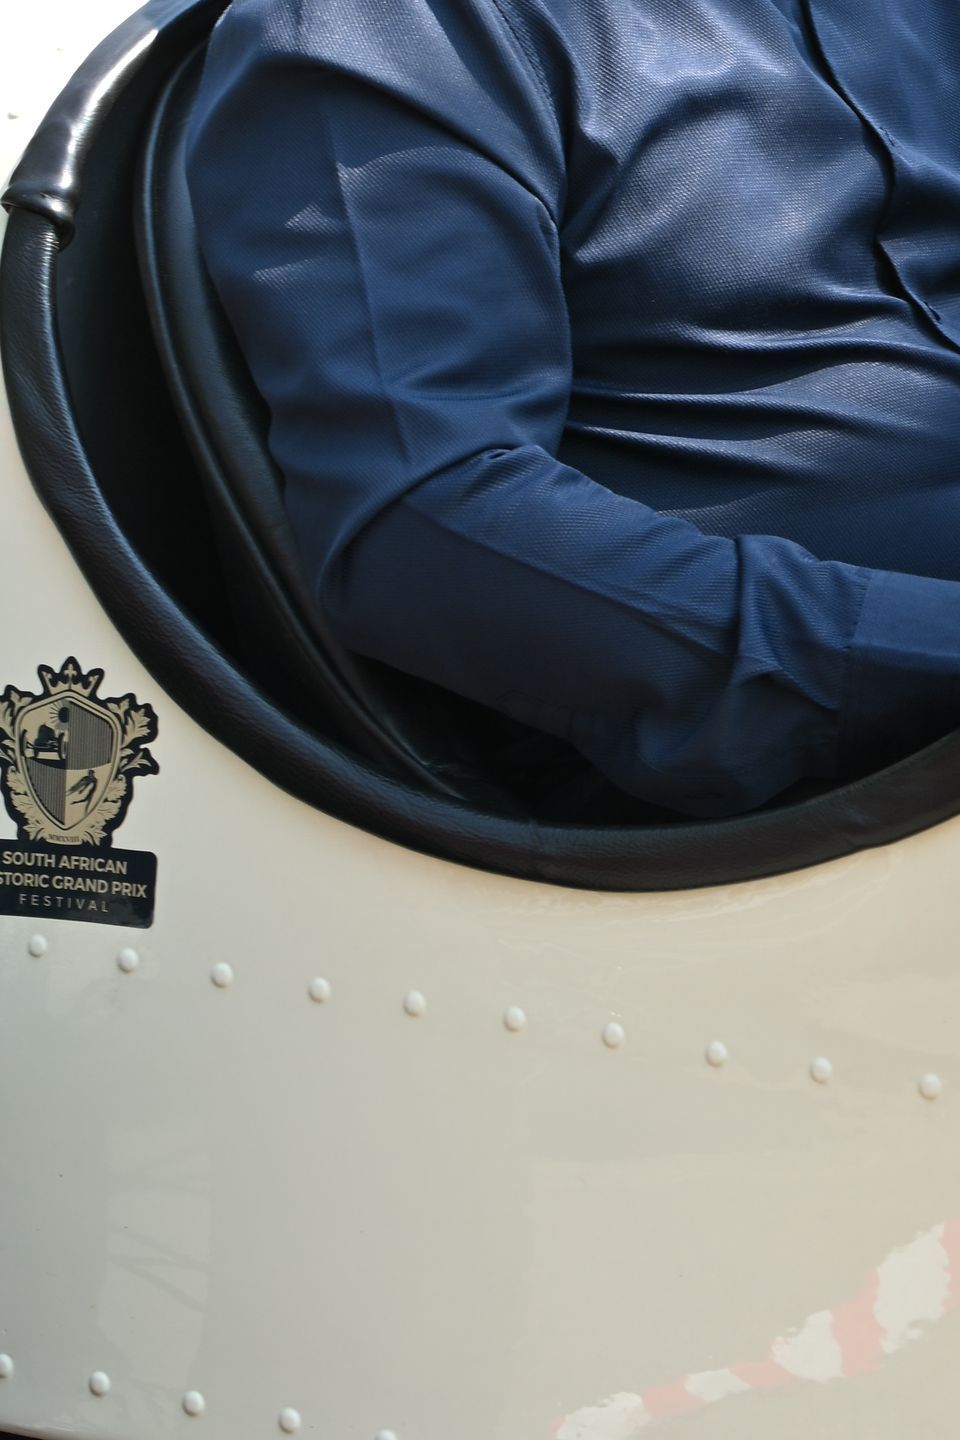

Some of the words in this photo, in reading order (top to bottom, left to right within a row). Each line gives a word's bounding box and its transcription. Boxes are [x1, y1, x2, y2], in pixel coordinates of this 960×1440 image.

[2, 851, 55, 868] SOUTH
[58, 855, 128, 875] AFRICAN
[52, 875, 108, 894] GRAND
[111, 881, 147, 898] PRIX
[19, 893, 109, 913] FESTIVAL
